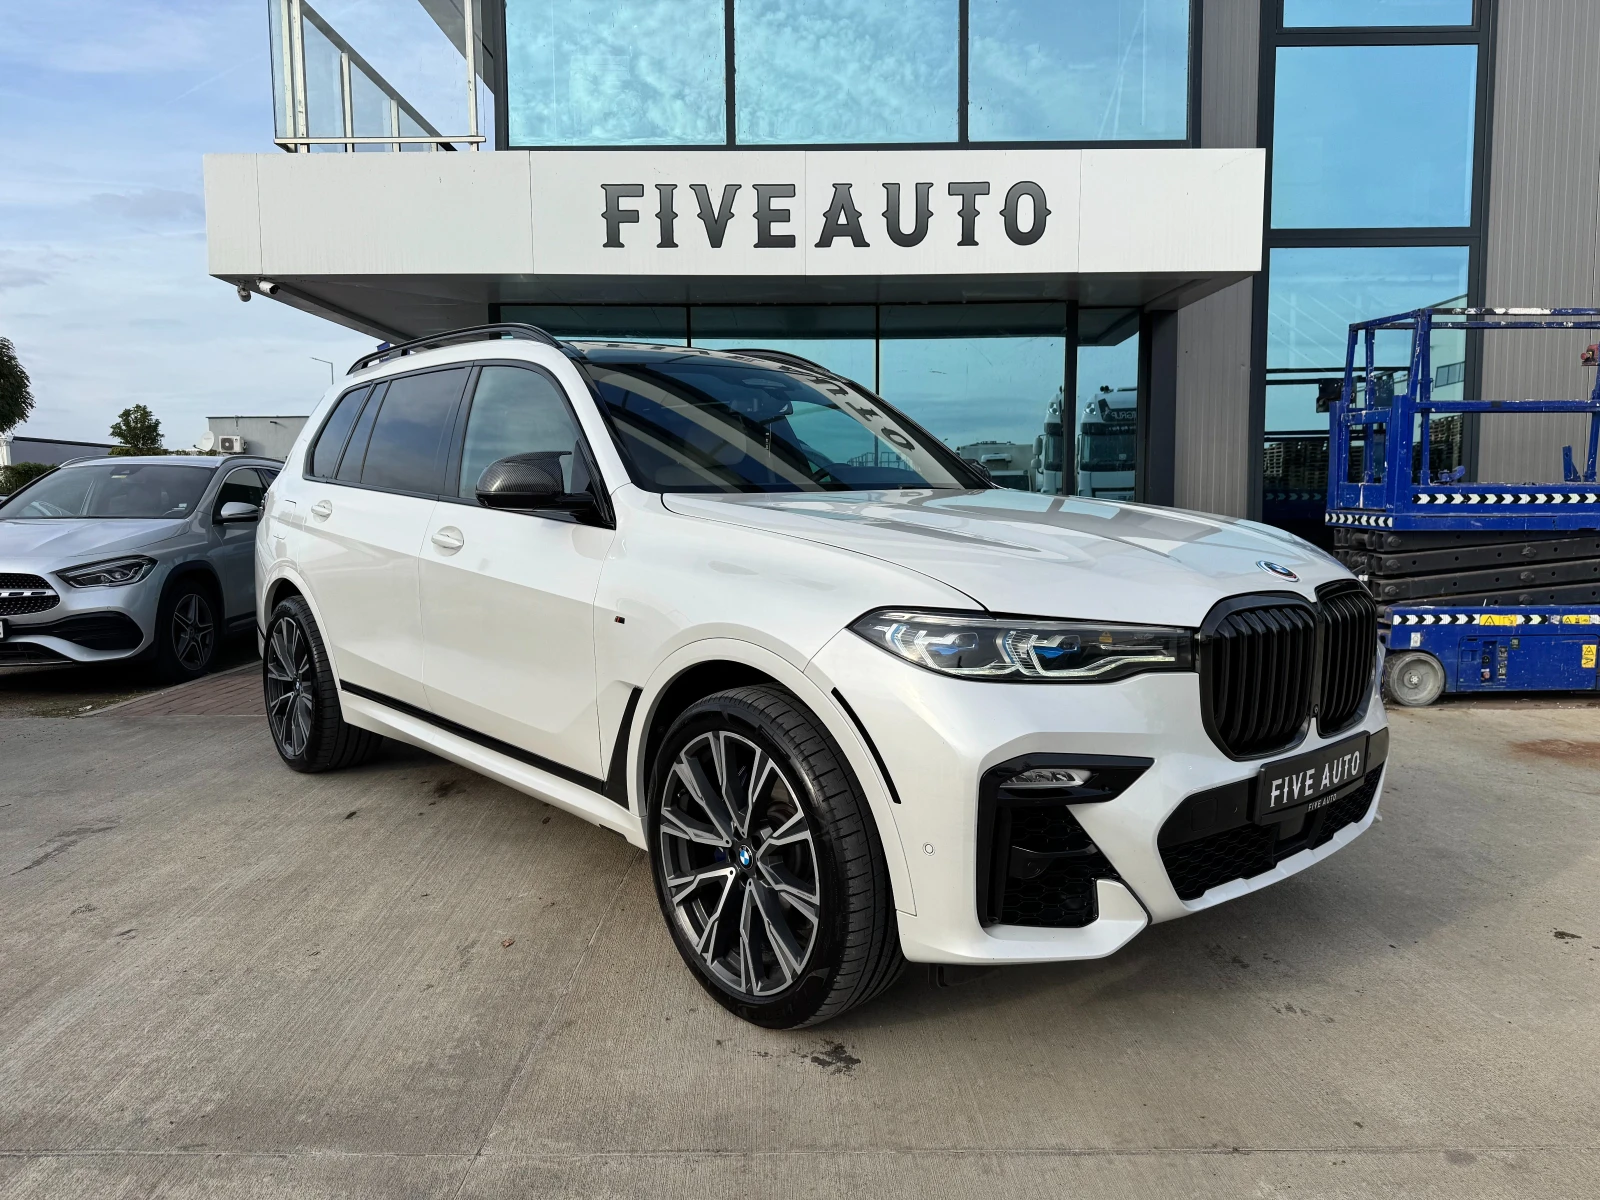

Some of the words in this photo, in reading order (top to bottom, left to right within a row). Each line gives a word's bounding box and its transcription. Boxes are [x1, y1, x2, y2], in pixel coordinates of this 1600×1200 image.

[1270, 768, 1316, 808] FIVE
[1320, 751, 1360, 790] AUTO
[1307, 799, 1321, 812] FIVE
[1322, 793, 1337, 806] AUTO
